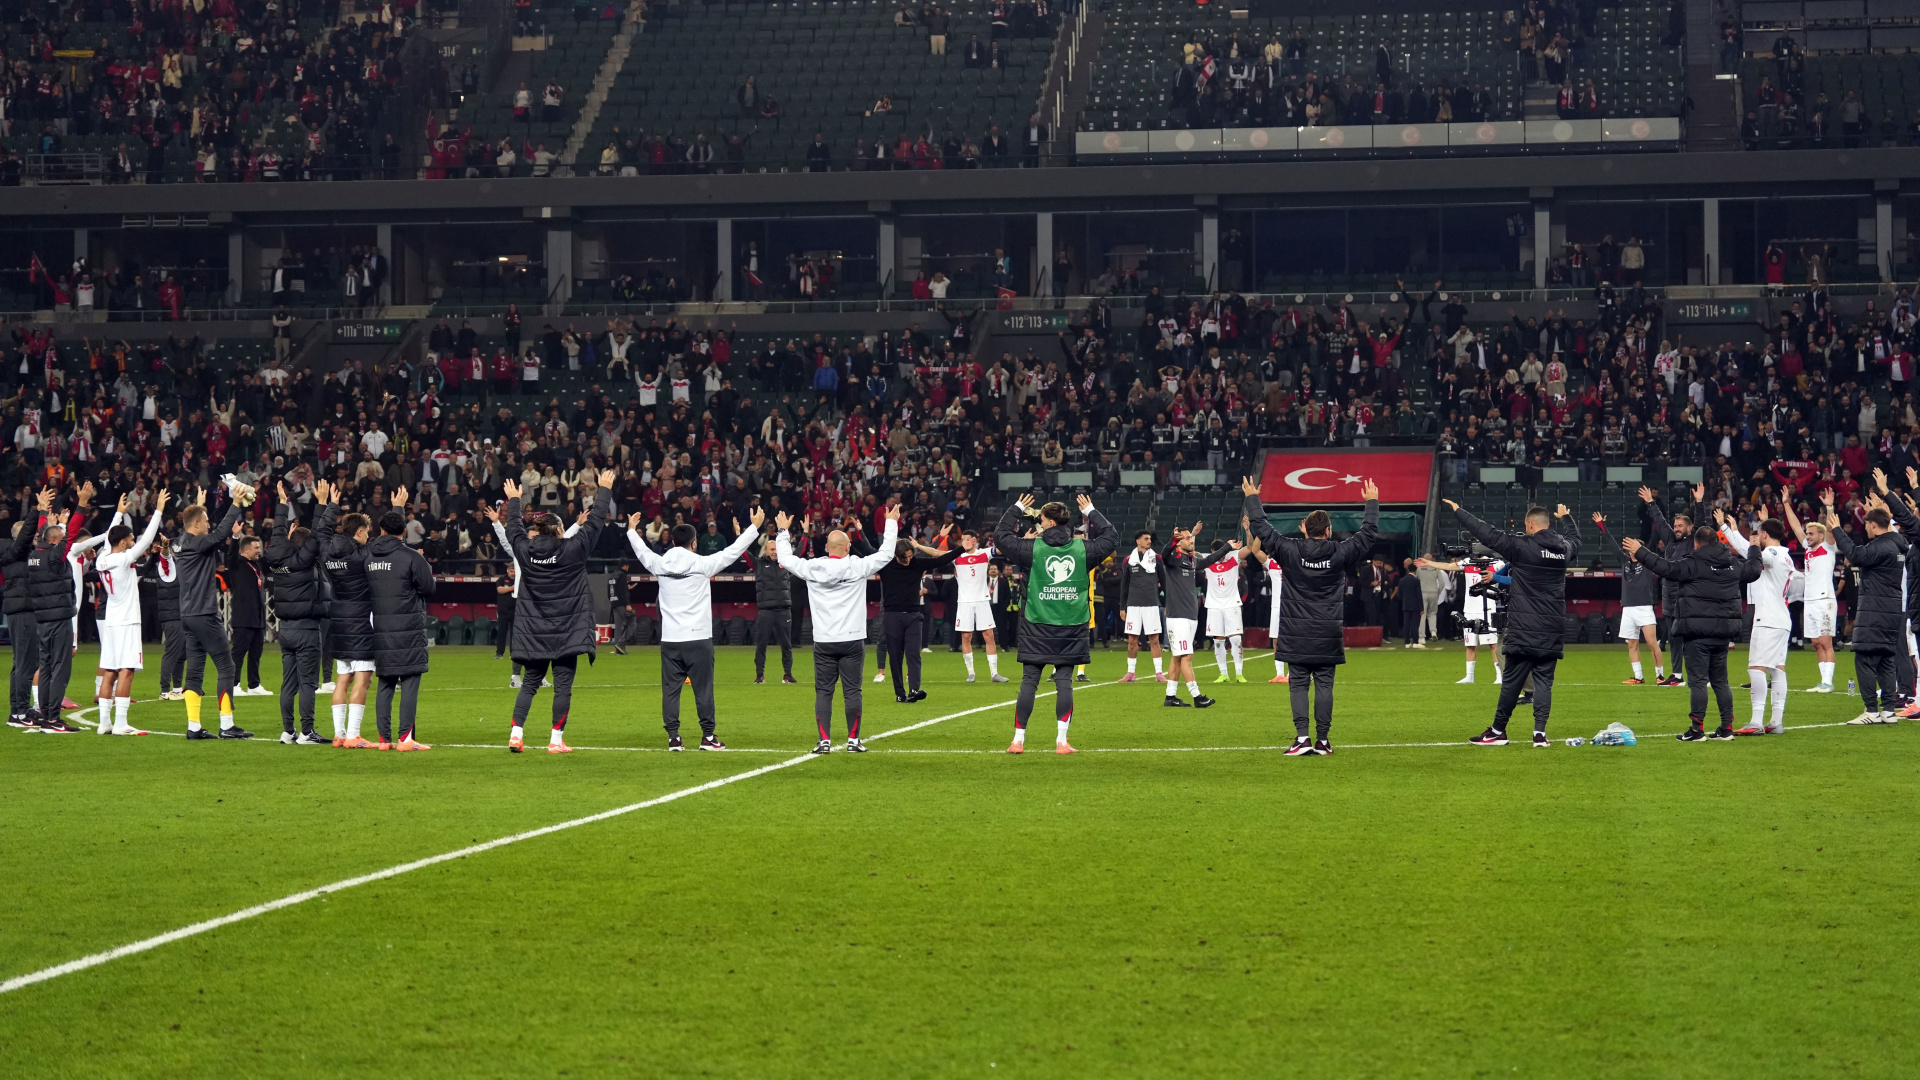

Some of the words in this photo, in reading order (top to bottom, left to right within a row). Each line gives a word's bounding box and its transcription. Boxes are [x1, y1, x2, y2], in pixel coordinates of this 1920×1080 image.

[1686, 305, 1699, 317] 113
[1705, 305, 1718, 317] 114
[1011, 316, 1024, 328] 112
[1029, 316, 1042, 328] 113
[364, 325, 374, 337] 112
[326, 560, 348, 570] TÜRKİYE
[368, 560, 392, 571] TÜRKİYE
[1217, 578, 1225, 586] 14
[1126, 622, 1133, 631] 15
[1179, 640, 1188, 650] 10
